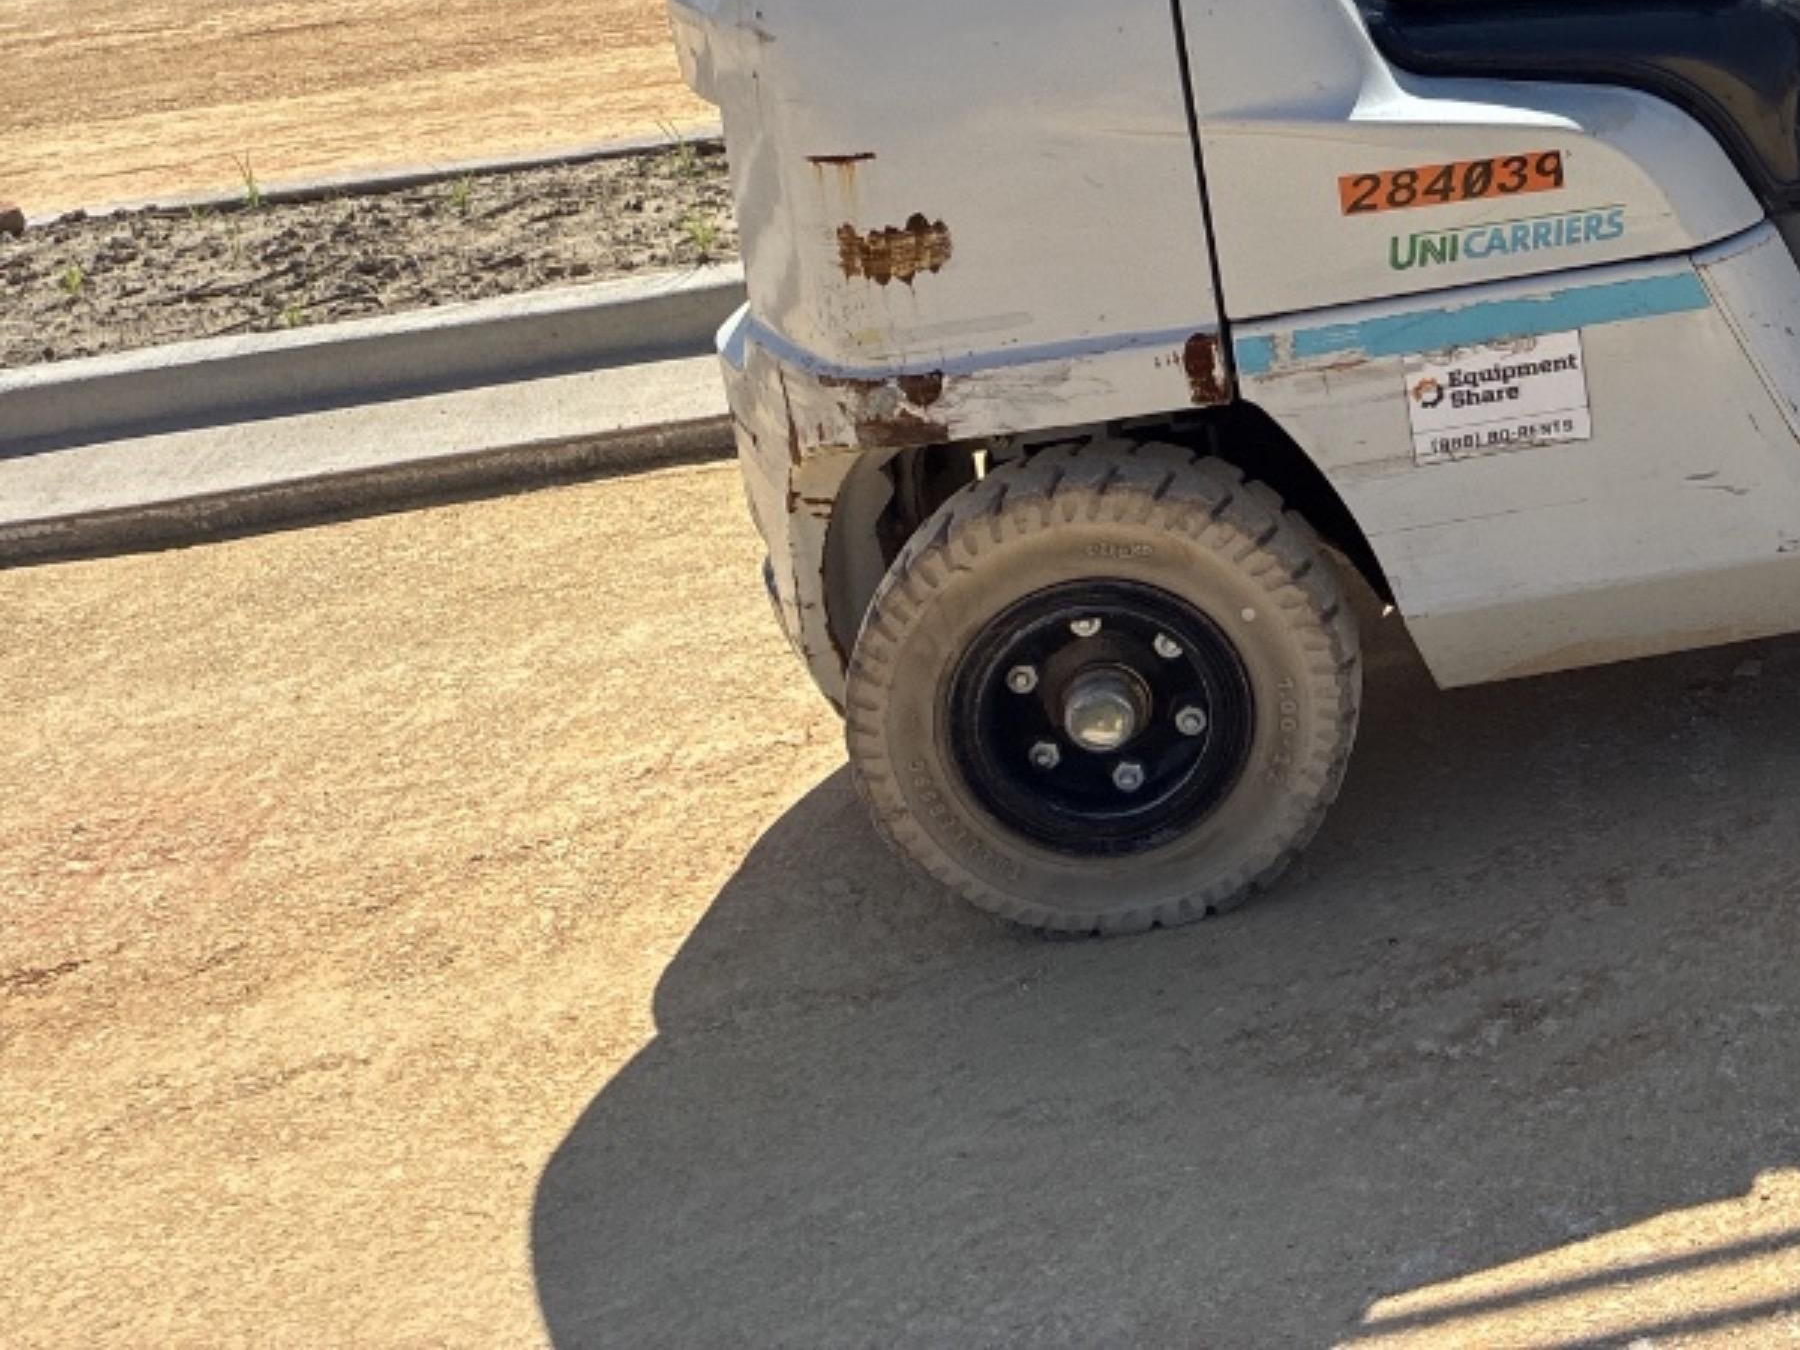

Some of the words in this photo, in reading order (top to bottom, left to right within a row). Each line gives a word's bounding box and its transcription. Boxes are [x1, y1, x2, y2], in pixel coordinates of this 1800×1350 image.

[1346, 149, 1563, 215] 284039
[1389, 208, 1625, 270] UNICARRIERS
[1447, 353, 1578, 389] Equipment
[1450, 385, 1519, 409] Share
